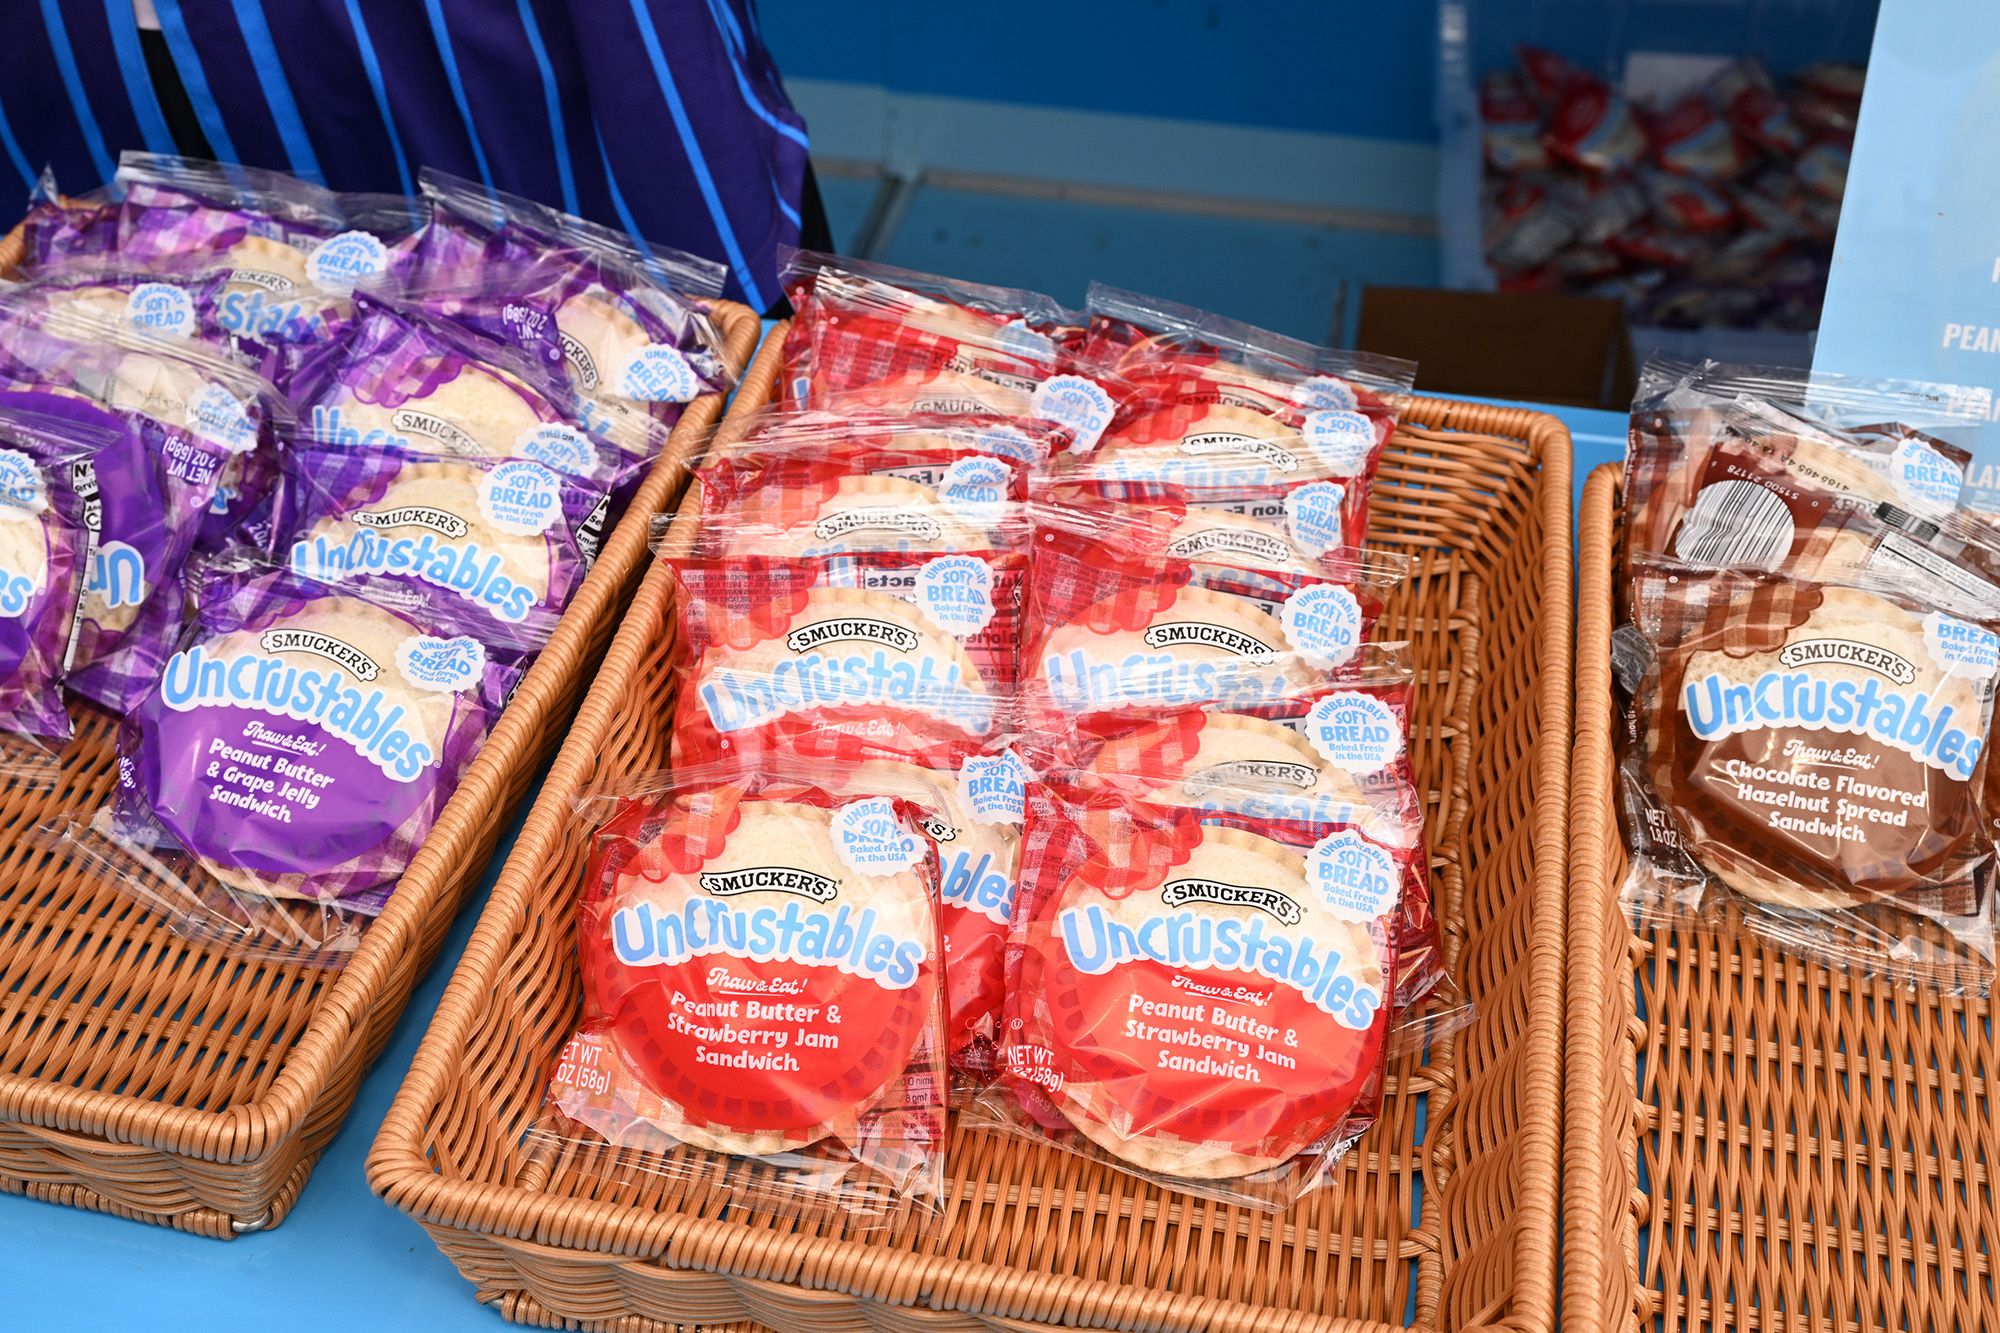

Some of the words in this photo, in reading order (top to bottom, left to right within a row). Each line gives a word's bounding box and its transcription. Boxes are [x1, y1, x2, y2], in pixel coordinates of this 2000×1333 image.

[317, 253, 375, 274] BREAD
[1048, 380, 1108, 414] UNBEATABLY
[1331, 418, 1359, 433] SOFT
[167, 458, 188, 478] WT
[191, 448, 209, 466] OZ
[186, 466, 213, 485] NET
[494, 463, 554, 486] UNBEATABLY
[509, 475, 539, 491] SOFT
[954, 461, 1006, 482] UNBEATAB
[1726, 464, 1761, 483] 21178
[1903, 463, 1963, 488] BREAD
[489, 486, 552, 510] BREAD
[946, 483, 999, 502] BREAD
[1764, 480, 1800, 500] 51500
[1310, 495, 1337, 513] SOFT
[362, 508, 460, 533] SMUCKER'S
[925, 559, 987, 585] UNBEATABLY
[943, 570, 973, 585] SOFT
[927, 585, 987, 605] BREAD
[1296, 589, 1357, 625] UNBEATABLY
[934, 604, 961, 613] Baked
[964, 605, 984, 615] Fresh
[940, 613, 950, 621] in
[951, 613, 966, 622] the
[967, 615, 981, 625] USA
[1312, 602, 1342, 623] SOFT
[799, 622, 909, 648] SMUCKER'S
[1293, 612, 1352, 646] BREAD
[1155, 628, 1266, 657] SMUCKER'S
[271, 632, 373, 680] SMUCKER'S
[408, 649, 472, 676] BREAD
[1791, 642, 1907, 678] SMUCKER'S
[1945, 651, 1956, 661] in
[1976, 656, 1995, 667] USA
[165, 650, 430, 778] Uncrustables
[1316, 697, 1388, 720] UNBEATABLY
[1335, 711, 1368, 725] SOFT
[1320, 725, 1390, 743] BREAD
[1686, 672, 1982, 778] Uncrustables
[1329, 743, 1358, 752] Baked
[1360, 743, 1385, 753] Fresh
[1336, 751, 1345, 760] in
[1347, 752, 1363, 760] the
[1364, 752, 1382, 762] USA
[208, 738, 272, 770] Peanut
[273, 758, 336, 789] Butter
[984, 764, 1015, 779] SOFT
[206, 761, 220, 778] &
[222, 765, 276, 795] Grape
[280, 780, 321, 810] Jelly
[1725, 758, 1832, 791] Chocolate
[1836, 775, 1927, 809] Flavored
[208, 783, 292, 824] Sandwich
[974, 794, 1000, 806] Baked
[977, 806, 986, 814] in
[988, 803, 1003, 811] the
[1005, 804, 1024, 815] USA
[1737, 783, 1831, 813] Hazelnut
[1836, 799, 1909, 828] Spread
[861, 819, 897, 839] SOFT
[1768, 811, 1867, 845] Sandwich
[850, 844, 881, 854] Baked
[855, 854, 866, 862] in
[868, 853, 886, 862] the
[888, 853, 908, 862] USA
[1319, 836, 1391, 872] UNBEATABLY
[1338, 850, 1372, 871] SOFT
[711, 873, 829, 897] SMUCKER'S
[1318, 862, 1389, 895] BREAD
[1172, 882, 1294, 917] SMUCKER'S
[1323, 882, 1352, 898] Baked
[1354, 891, 1379, 905] Fresh
[1326, 894, 1336, 904] in
[1338, 897, 1354, 908] the
[1356, 902, 1373, 913] USA
[612, 899, 925, 988] Uncrustables
[1062, 906, 1380, 1029] Uncrustables
[669, 990, 740, 1020] Peanut
[745, 1000, 819, 1025] Butter
[826, 1004, 842, 1025] &
[666, 1011, 789, 1049] Strawberry
[794, 1027, 840, 1050] Jam
[1127, 993, 1205, 1023] Peanut
[1211, 1005, 1280, 1039] Butter
[1284, 1029, 1299, 1047] &
[561, 1041, 580, 1061] ET
[581, 1043, 603, 1067] WT
[1008, 1045, 1031, 1065] NET
[1034, 1046, 1054, 1065] WT
[1125, 1020, 1250, 1059] Strawberry
[1255, 1044, 1297, 1070] Jam
[694, 1045, 801, 1073] Sandwich
[1157, 1050, 1261, 1083] Sandwich
[557, 1062, 576, 1084] OZ
[575, 1065, 611, 1095] (58g)
[1030, 1066, 1064, 1093] (58g)
